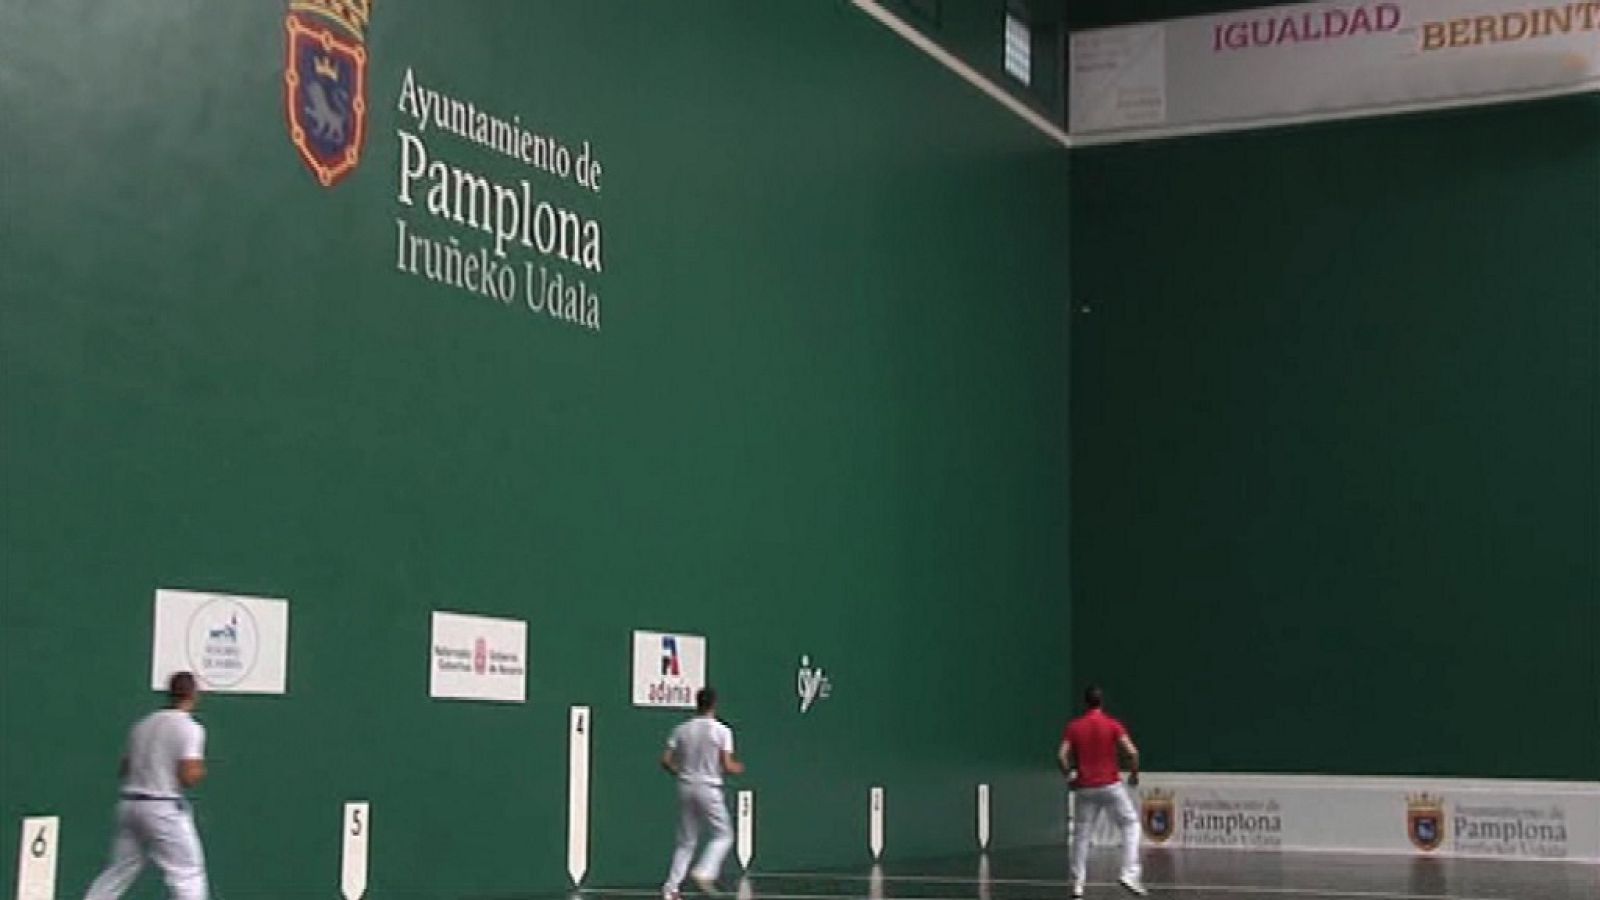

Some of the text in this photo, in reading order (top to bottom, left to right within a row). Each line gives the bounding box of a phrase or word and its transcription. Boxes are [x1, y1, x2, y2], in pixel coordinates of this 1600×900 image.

[1214, 2, 1600, 51] IGUALDAD BERDINT
[399, 67, 601, 192] Ayuntamiento de
[398, 129, 601, 272] Pamplona
[397, 217, 600, 331] Iruñeko Udala
[32, 825, 47, 858] 6
[351, 809, 362, 836] 5
[1183, 807, 1281, 836] Pamplona
[1455, 816, 1567, 842] Pamplona
